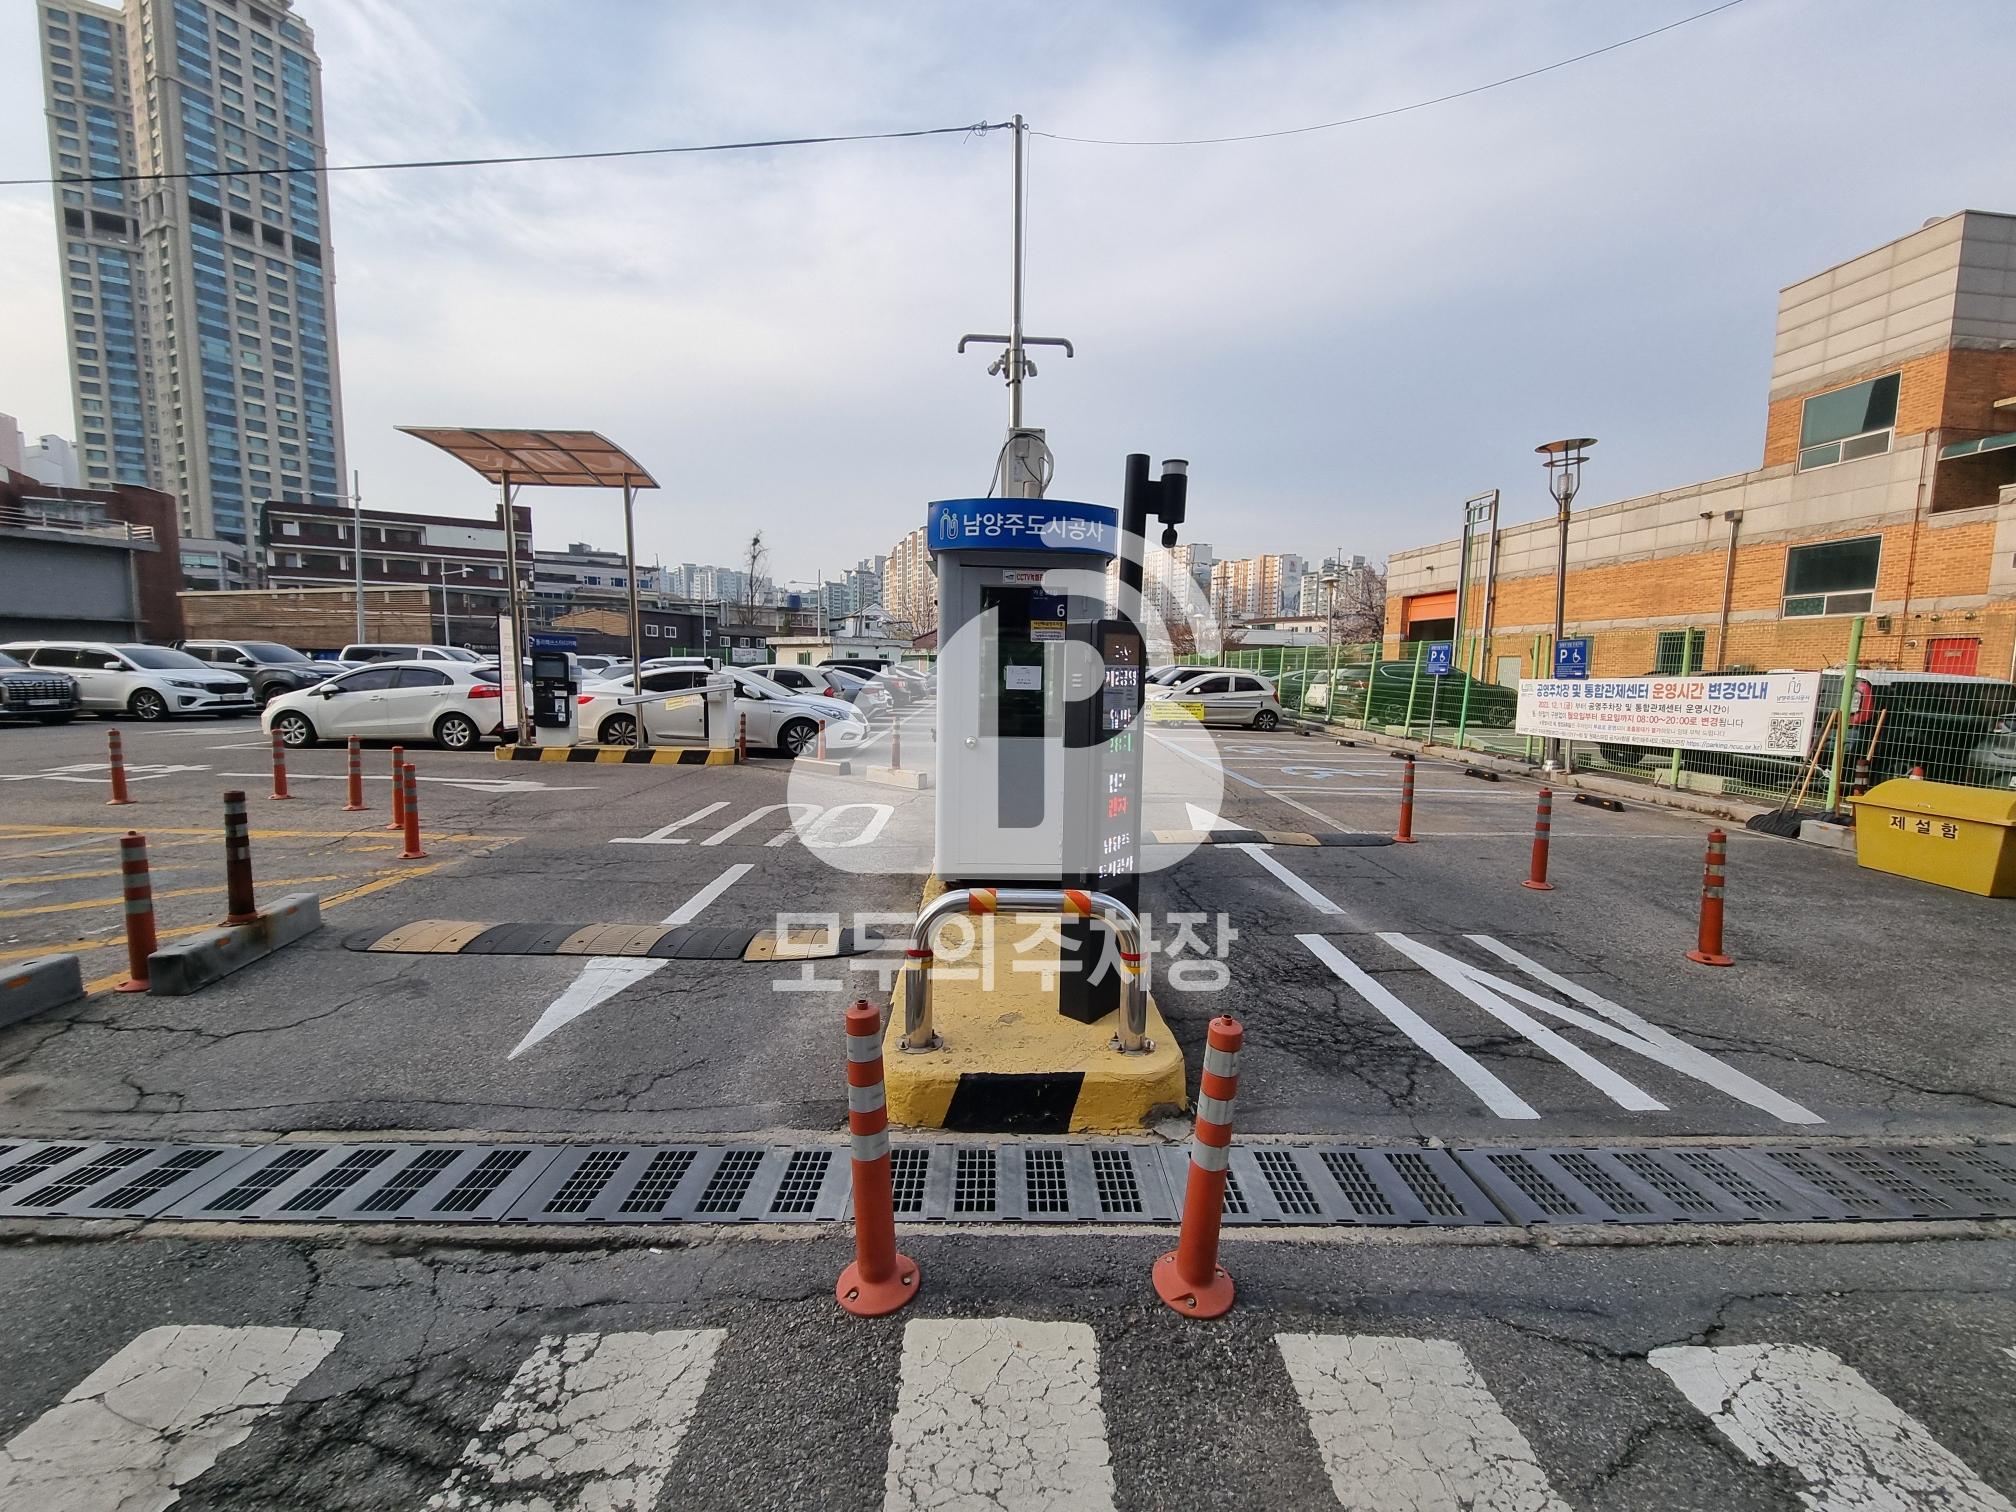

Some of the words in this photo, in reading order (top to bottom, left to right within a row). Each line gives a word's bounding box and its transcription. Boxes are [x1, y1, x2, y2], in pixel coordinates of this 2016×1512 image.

[963, 512, 1104, 542] 남양주도시공사
[1056, 604, 1065, 618] 6
[1431, 650, 1437, 662] P
[1560, 649, 1568, 663] P
[1536, 683, 1570, 698] 공영주차장
[1572, 684, 1581, 697] 및
[1584, 683, 1649, 699] 통합관제센터
[1652, 682, 1704, 699] 운영시간
[1708, 682, 1769, 700] 변경안내
[1588, 702, 1622, 712] 공영주차장
[1625, 703, 1632, 711] 및
[1635, 703, 1682, 713] 통합관제센터
[1686, 704, 1730, 714] 운영시간이
[1568, 711, 1598, 721] 월요일부터
[1600, 713, 1635, 723] 토요일까지
[1701, 717, 1744, 727] 변경됩니다
[1891, 816, 1959, 839] 제설함
